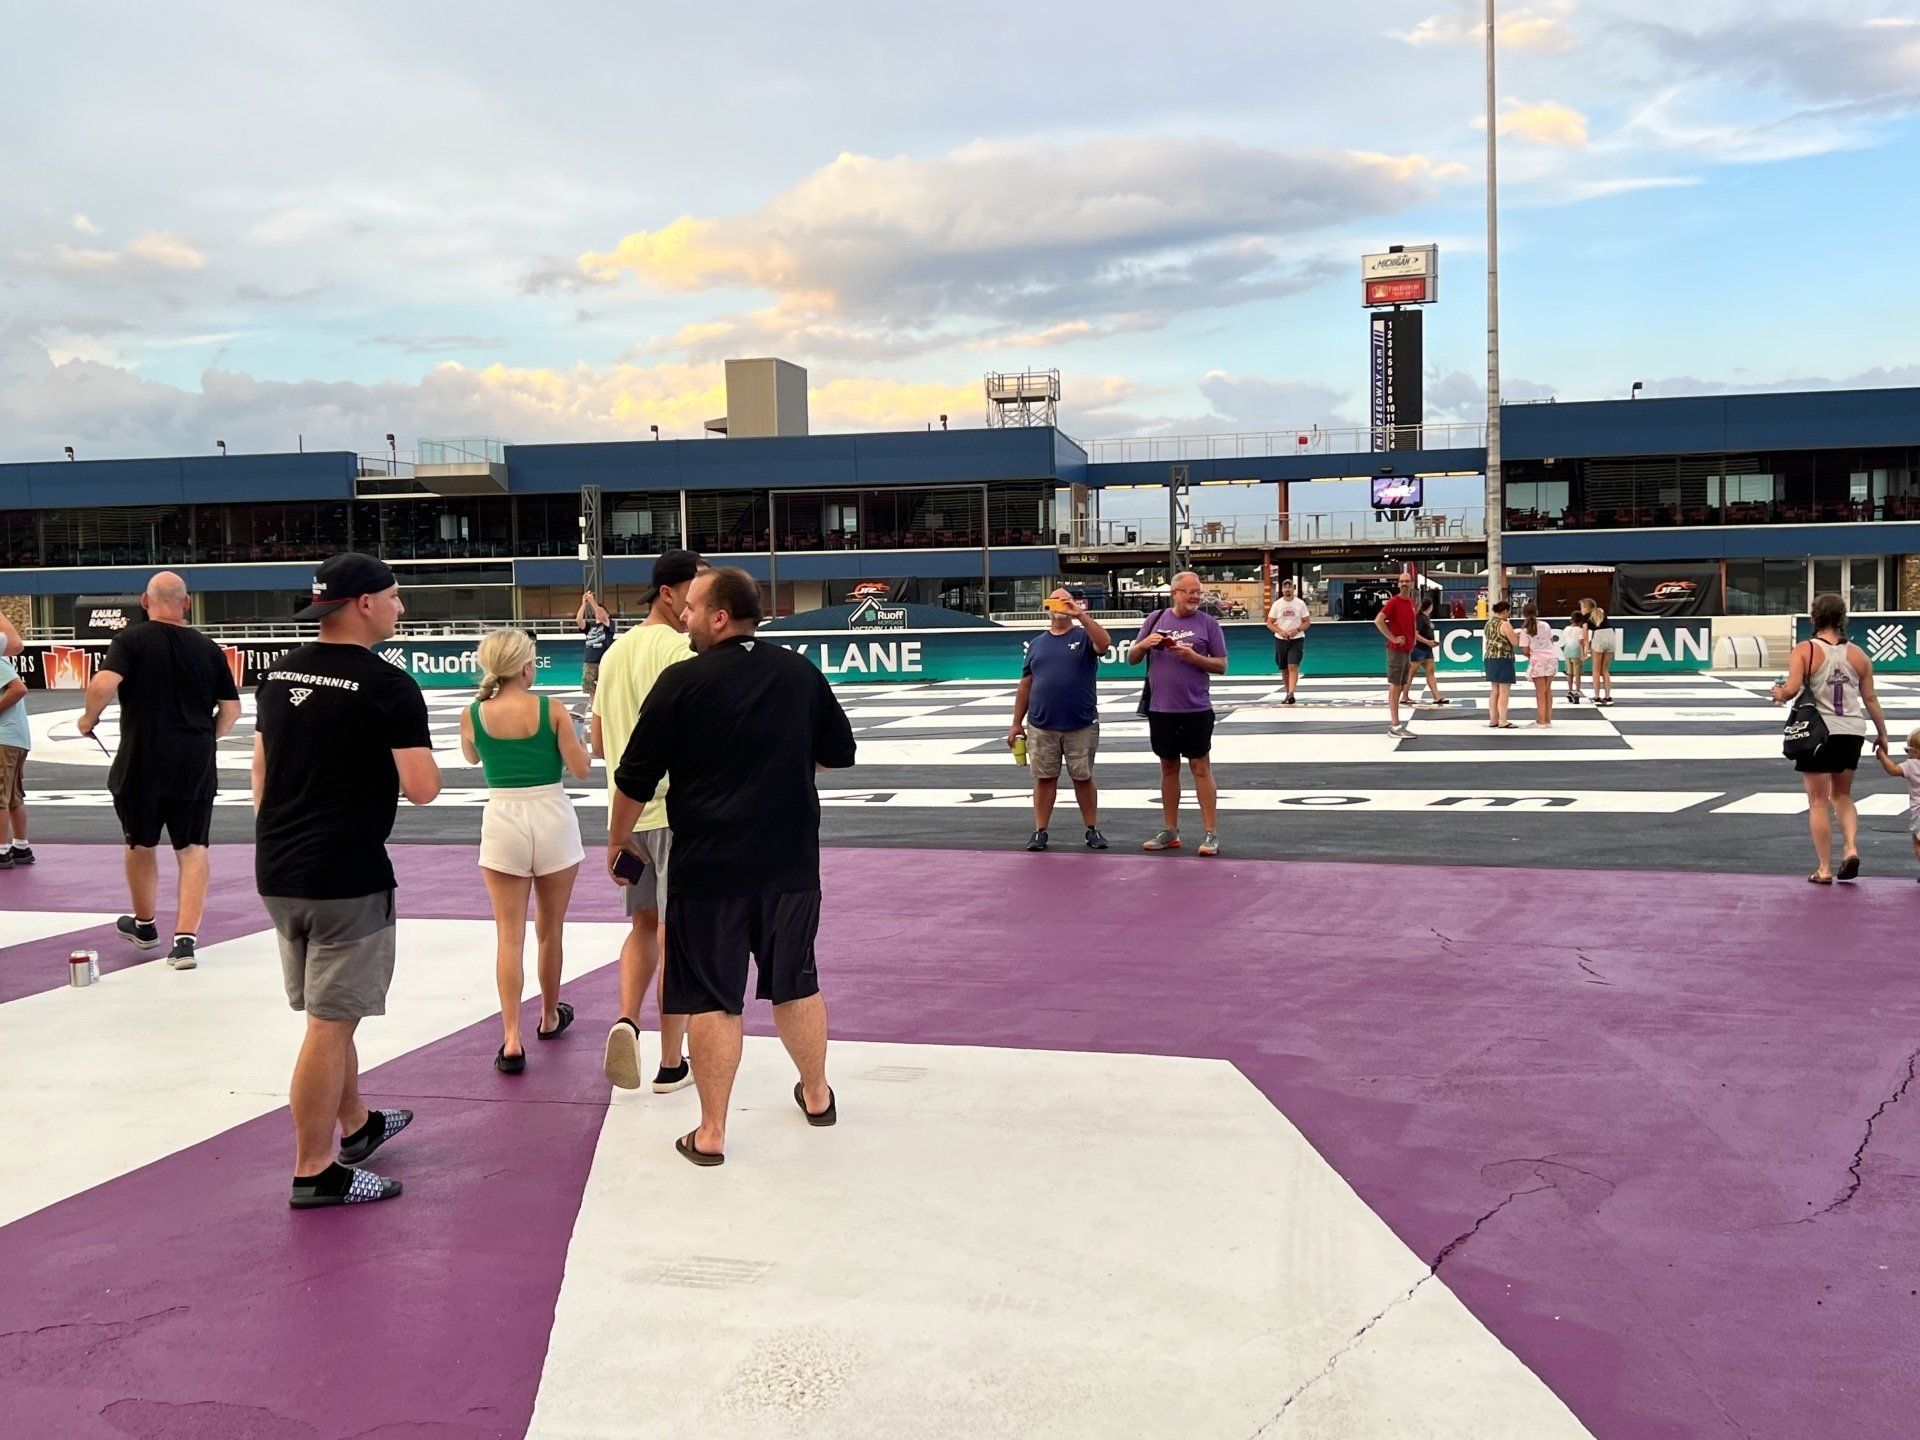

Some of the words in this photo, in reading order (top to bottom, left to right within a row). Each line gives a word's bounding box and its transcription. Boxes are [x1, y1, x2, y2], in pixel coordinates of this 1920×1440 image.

[1377, 256, 1411, 269] MICHIGAN
[1387, 321, 1392, 329] 1
[1387, 330, 1392, 338] 2
[1387, 340, 1393, 348] 3
[1387, 349, 1393, 357] 4
[1387, 358, 1393, 366] 5
[1387, 367, 1393, 375] 6
[1387, 377, 1393, 385] 7
[1387, 386, 1393, 394] 8
[1387, 395, 1393, 404] 9
[1386, 404, 1395, 413] 10
[1386, 413, 1395, 422] 11
[1544, 567, 1588, 575] PEDESTRIAN
[91, 609, 122, 618] KAULIG
[877, 611, 904, 620] Ruoff
[88, 618, 120, 628] RACING
[412, 650, 478, 674] Ruoff
[820, 641, 923, 674] LANE
[267, 671, 360, 691] STACKINGPENNIES
